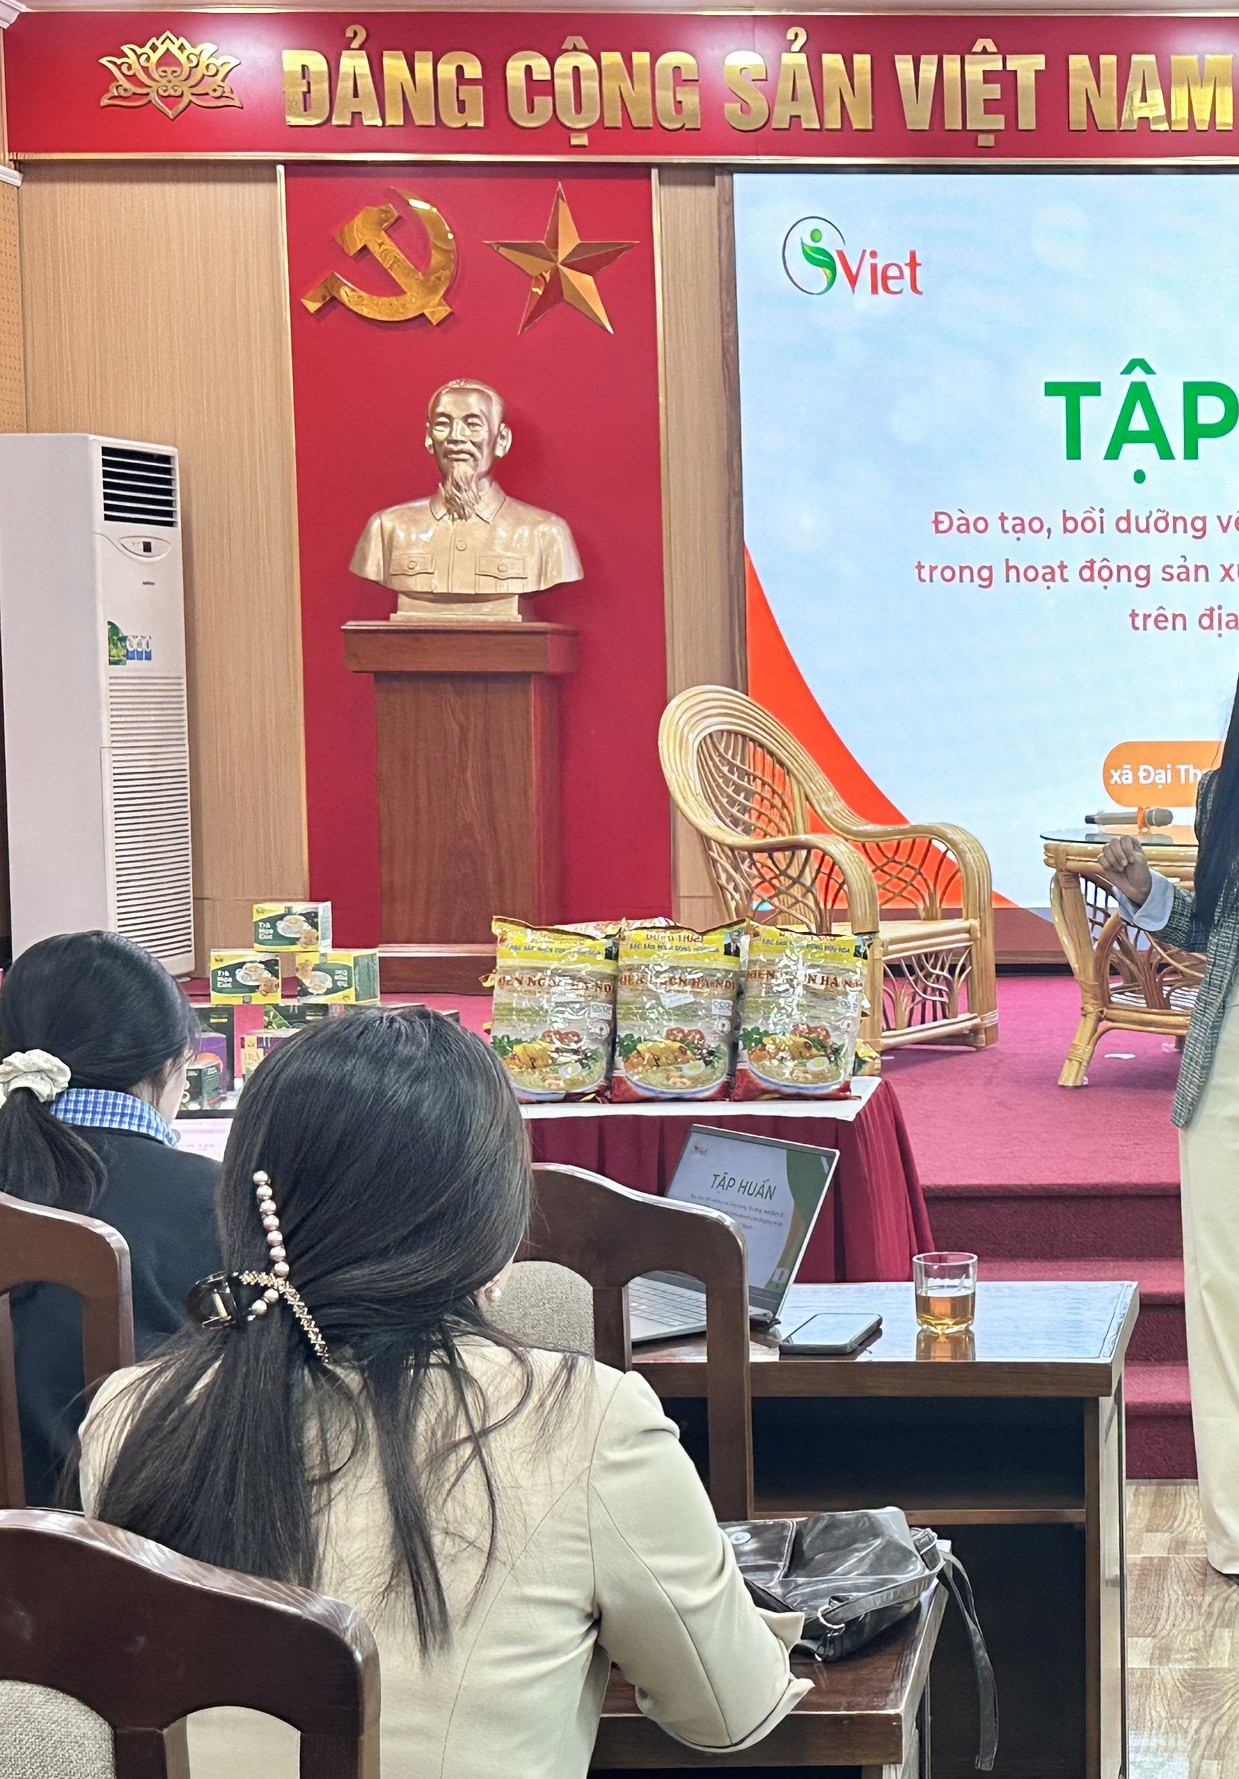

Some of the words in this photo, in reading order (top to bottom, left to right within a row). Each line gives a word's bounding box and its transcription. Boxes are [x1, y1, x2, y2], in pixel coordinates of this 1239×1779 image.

[281, 25, 485, 129] ĐẢNG
[506, 35, 700, 146] CỘNG
[723, 27, 873, 132] SẢN
[895, 38, 1046, 147] VIỆT
[1067, 54, 1234, 132] NAM
[1044, 358, 1239, 484] TẬP
[932, 509, 990, 535] Đào
[999, 512, 1053, 541] tạo,
[1062, 506, 1106, 534] bồi
[1115, 508, 1208, 540] dưỡng
[915, 560, 995, 589] trong
[1005, 558, 1070, 590] hoạt
[1078, 558, 1152, 590] động
[1161, 555, 1211, 584] sản
[1129, 606, 1188, 632] trên
[1109, 764, 1134, 785] xã
[1137, 763, 1172, 789] Đại
[1175, 763, 1211, 785] Th
[711, 1171, 736, 1194] TẬP
[737, 1178, 777, 1201] HUẤN
